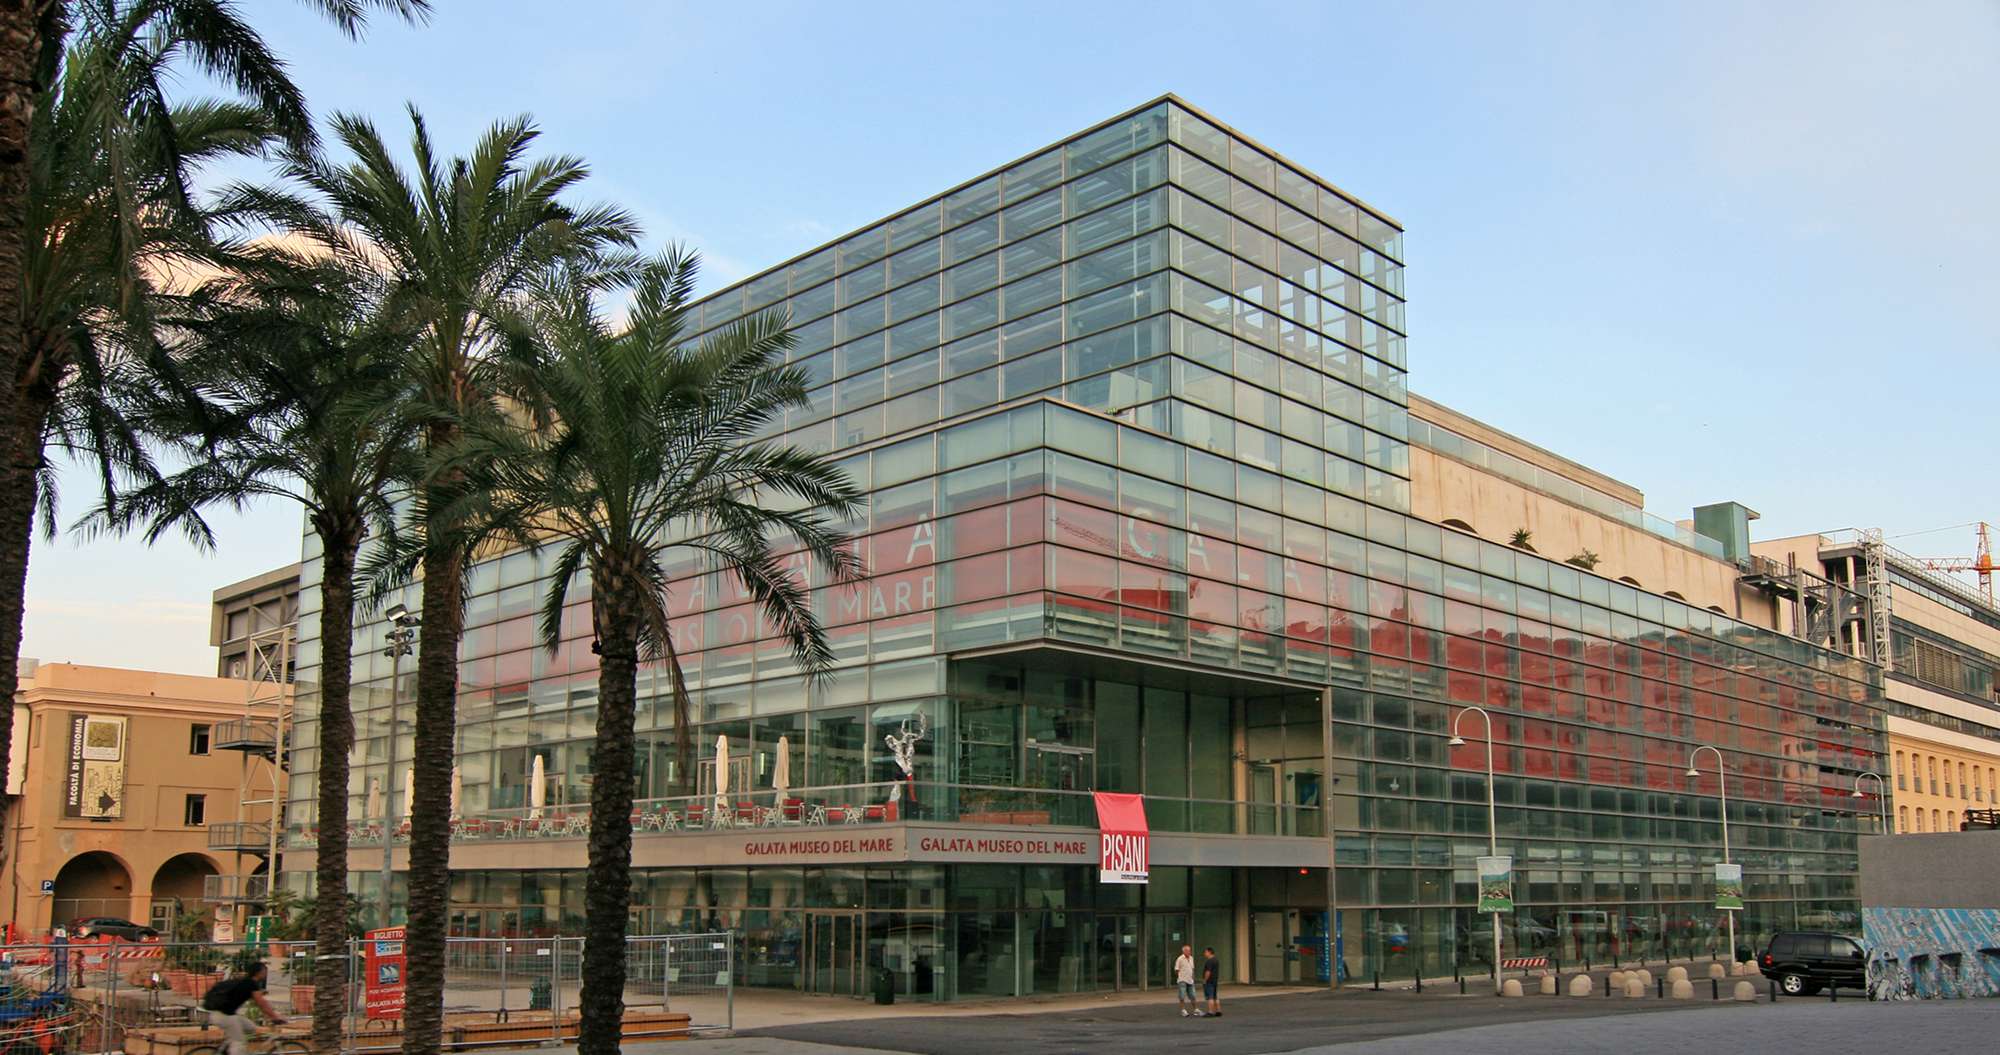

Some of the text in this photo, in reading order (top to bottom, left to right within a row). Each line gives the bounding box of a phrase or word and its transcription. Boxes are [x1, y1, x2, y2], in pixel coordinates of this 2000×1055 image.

[73, 718, 84, 760] ECONOMIA
[72, 761, 80, 771] DI
[745, 838, 893, 856] GALATA MUSEO DEL MARE
[920, 837, 1087, 854] GALATA MUSEO DEL MARE
[1103, 834, 1145, 872] PISANI
[43, 881, 52, 890] P
